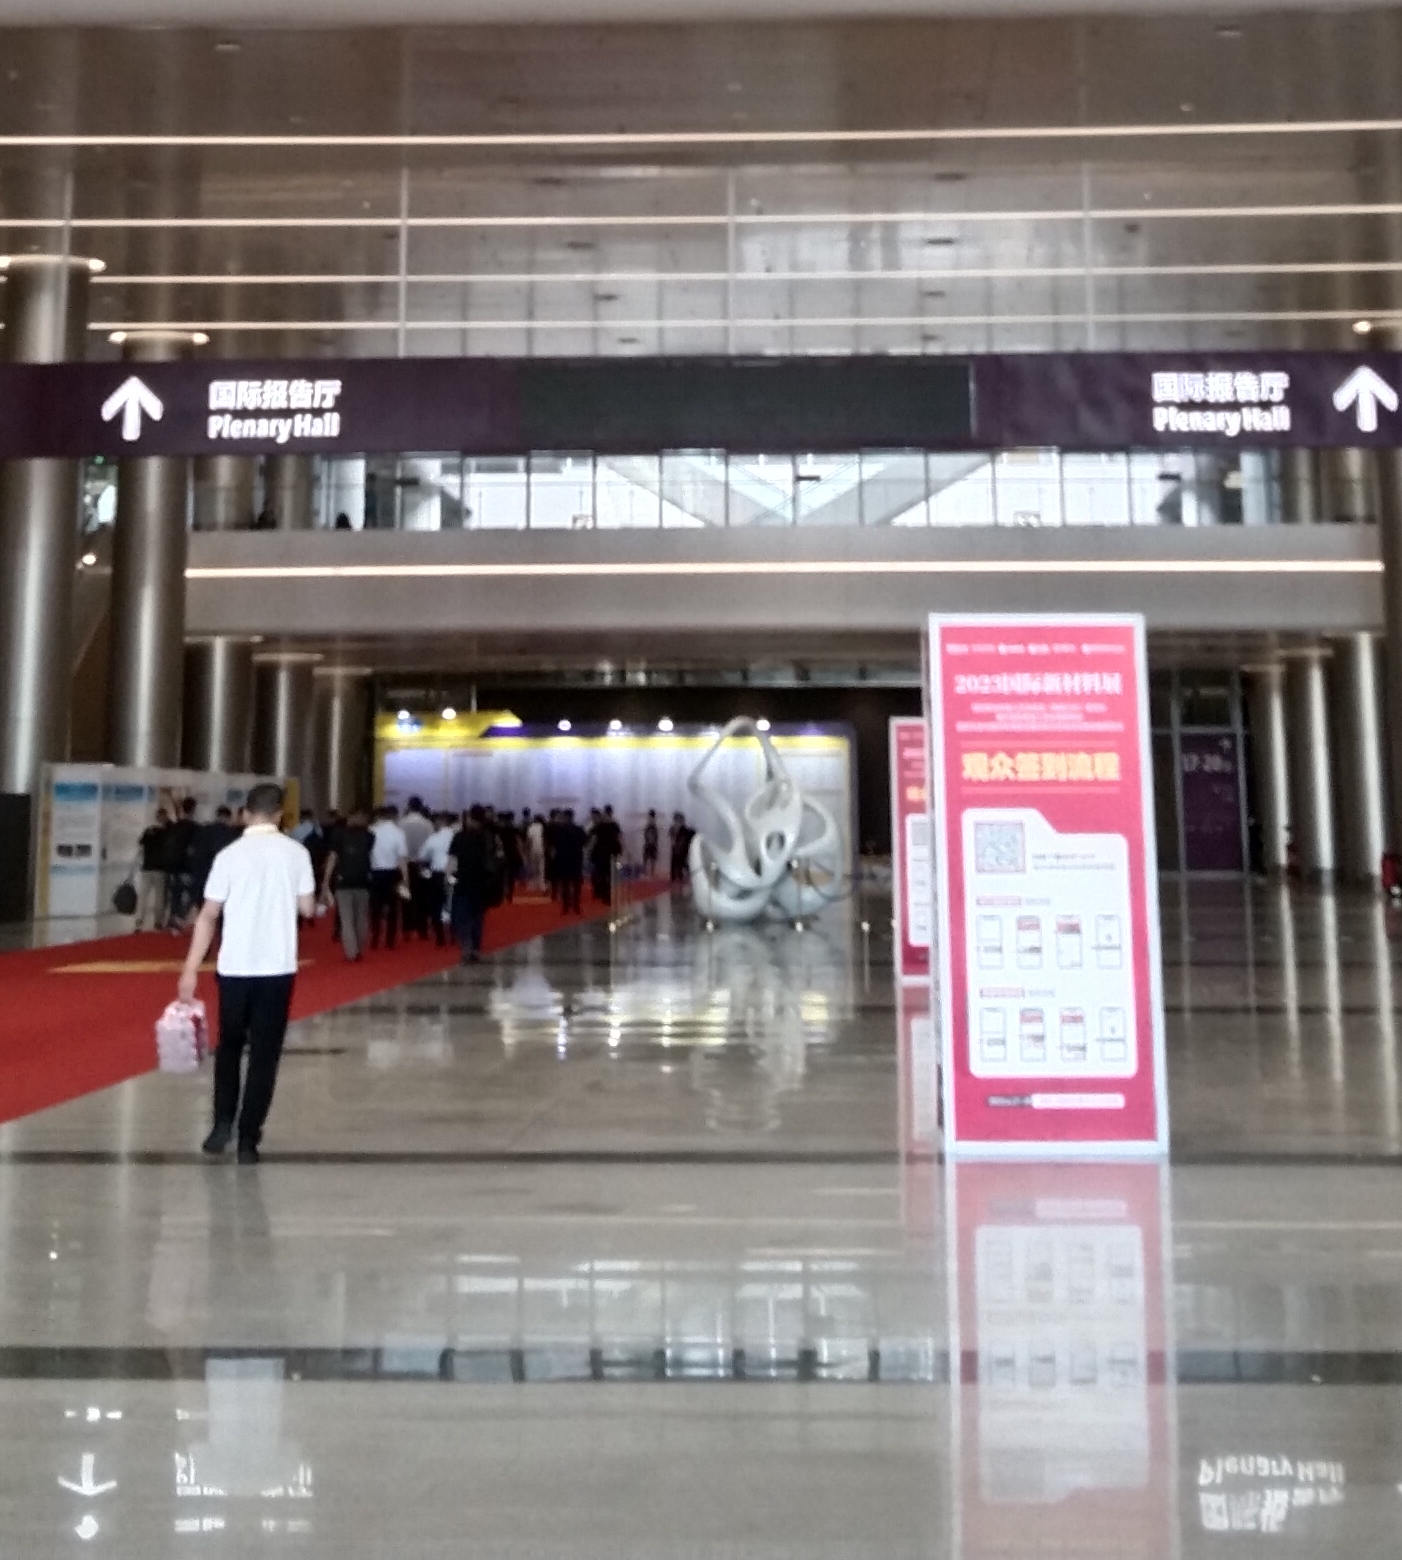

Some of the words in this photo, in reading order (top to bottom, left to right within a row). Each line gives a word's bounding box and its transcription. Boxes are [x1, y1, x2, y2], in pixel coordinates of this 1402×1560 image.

[208, 378, 343, 411] 国际报告厅
[207, 413, 294, 444] Plenary
[295, 411, 341, 438] Hall
[1152, 405, 1242, 437] Plenary
[1242, 403, 1291, 432] Hall
